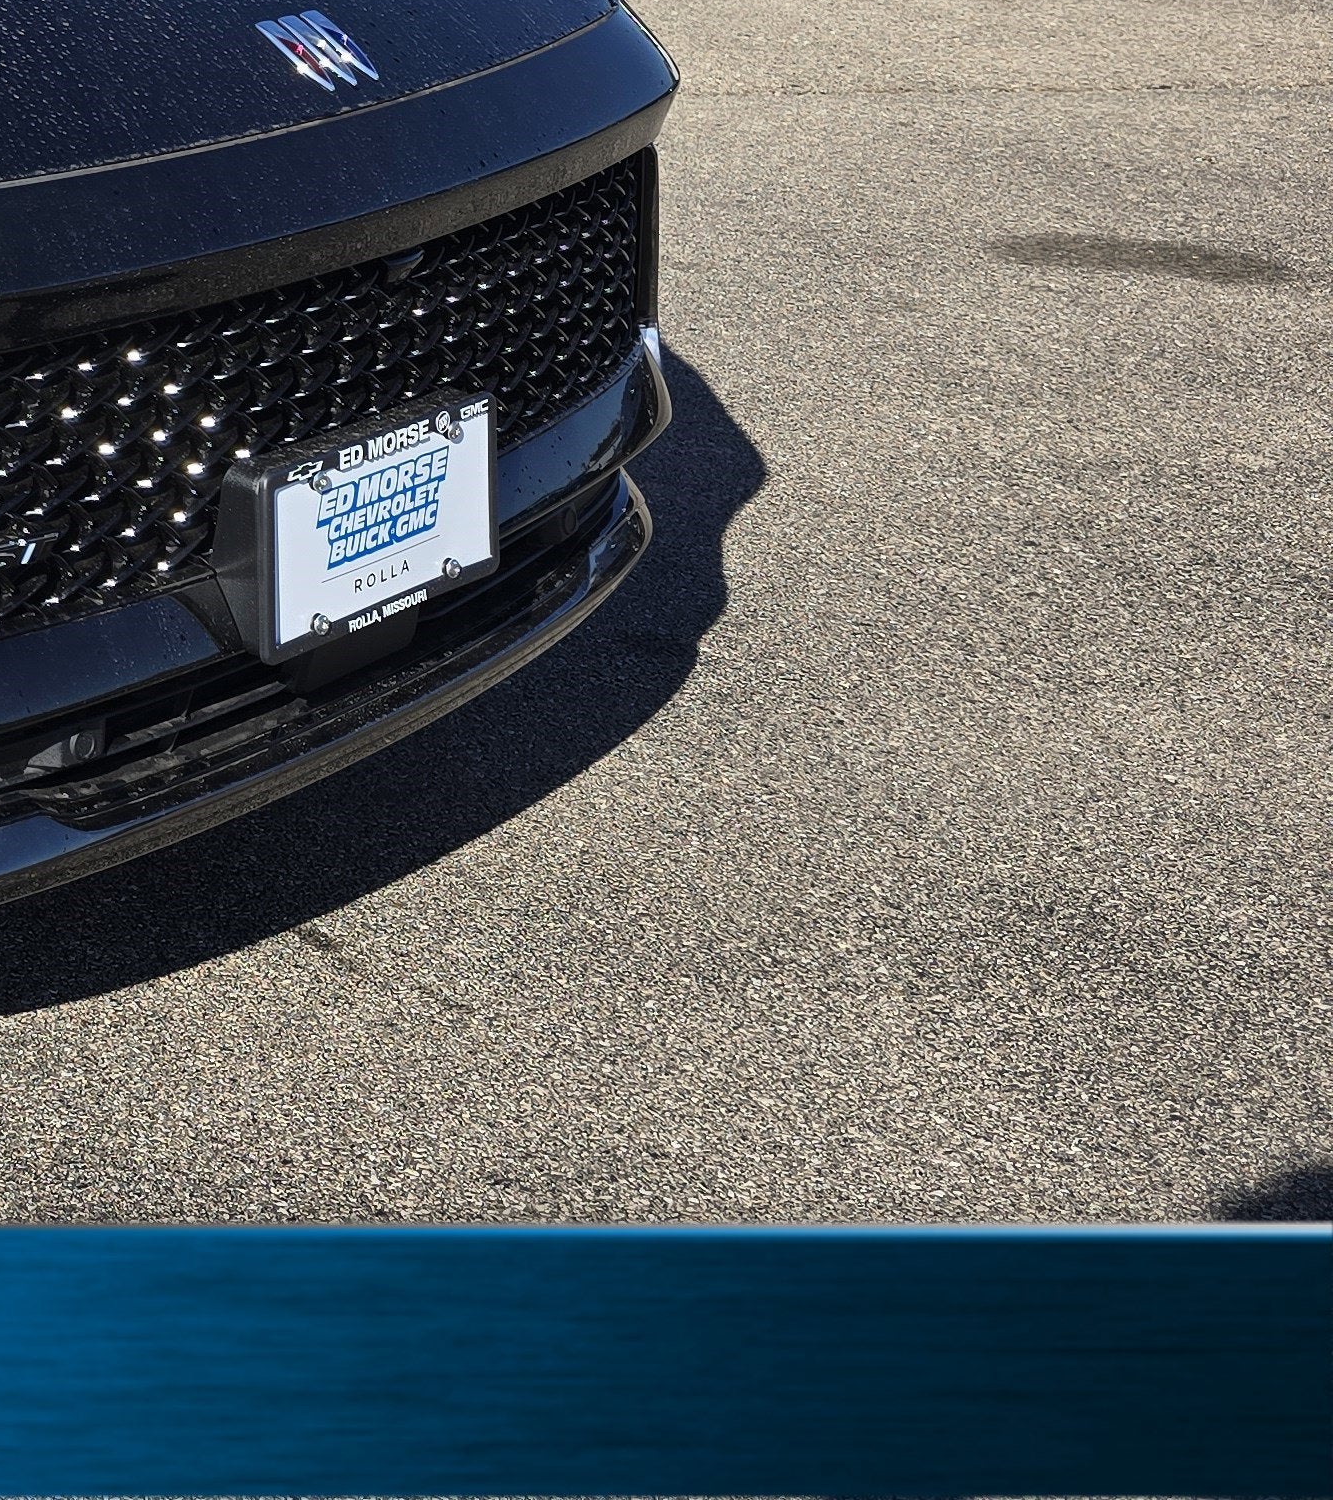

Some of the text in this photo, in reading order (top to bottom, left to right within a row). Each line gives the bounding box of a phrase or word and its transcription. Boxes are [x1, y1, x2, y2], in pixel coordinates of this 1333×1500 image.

[459, 398, 489, 420] GMC
[339, 419, 430, 471] ED MORSE
[318, 449, 449, 522] ED MORSE
[354, 559, 410, 594] ROLLA
[347, 588, 428, 633] ROLLA, MISSOURI
